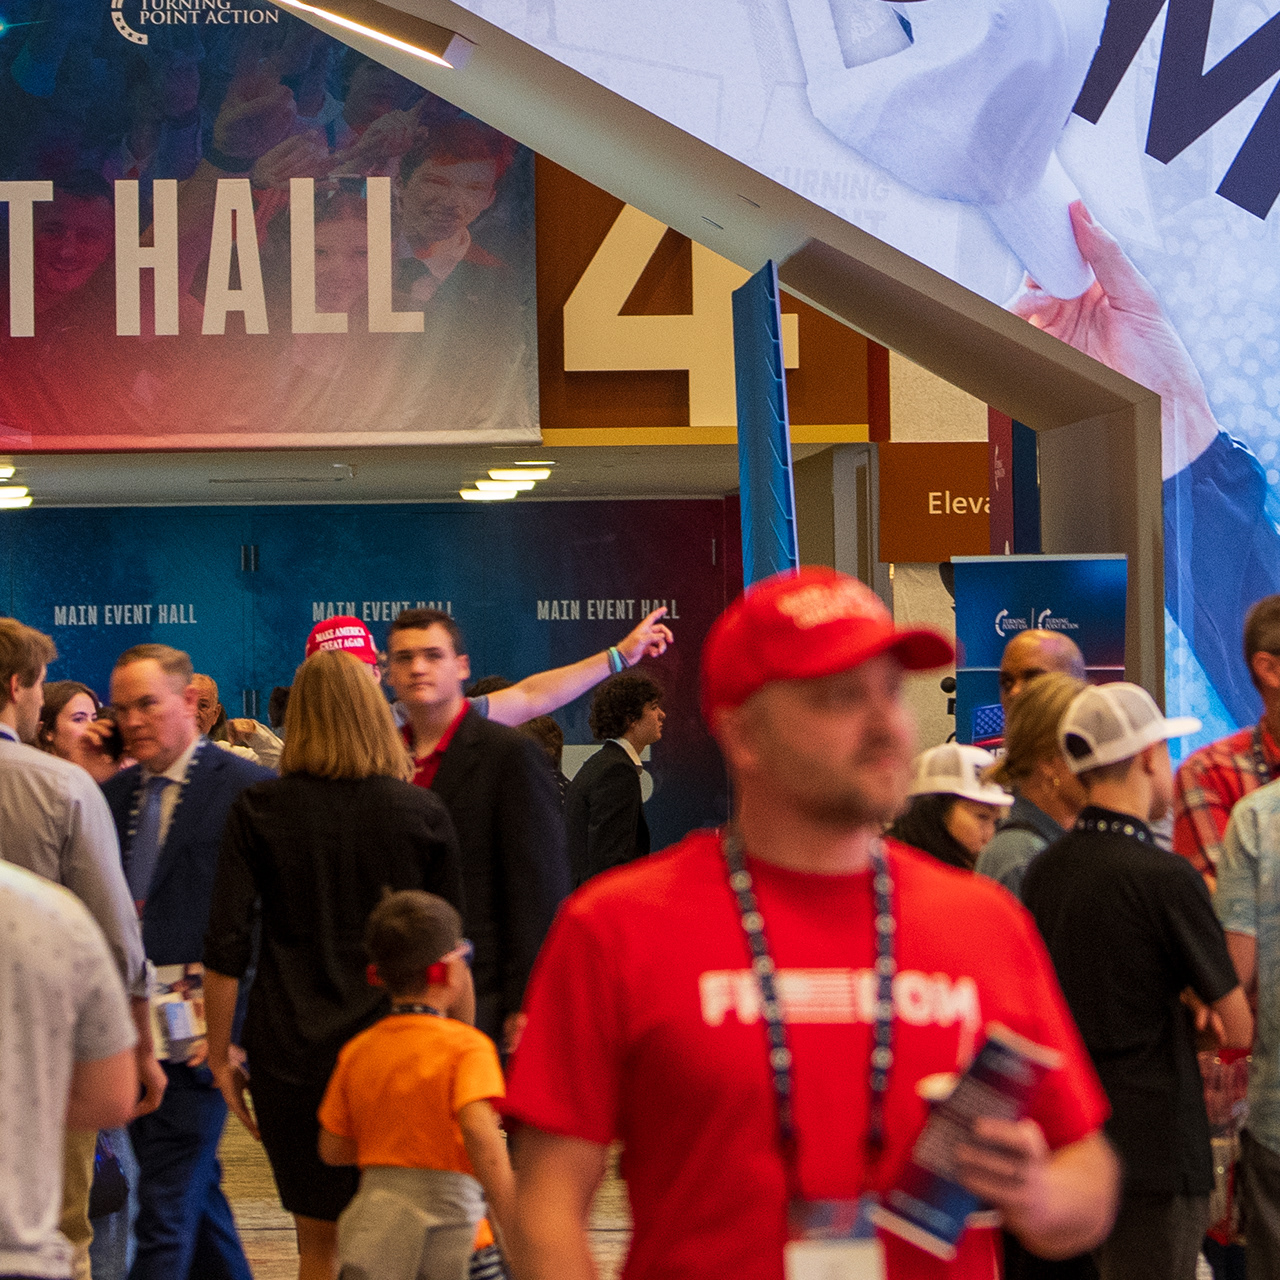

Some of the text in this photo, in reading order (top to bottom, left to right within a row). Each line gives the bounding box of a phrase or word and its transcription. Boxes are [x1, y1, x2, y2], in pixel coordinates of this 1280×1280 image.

[140, 9, 280, 25] POINT ACTION
[114, 176, 426, 337] HALL
[563, 202, 800, 428] 4
[54, 604, 197, 626] MAIN EVENT HALL
[312, 601, 356, 622] MAIN
[537, 599, 680, 620] MAIN EVENT HALL
[335, 626, 366, 637] AMERICA
[343, 637, 365, 648] AGAIN
